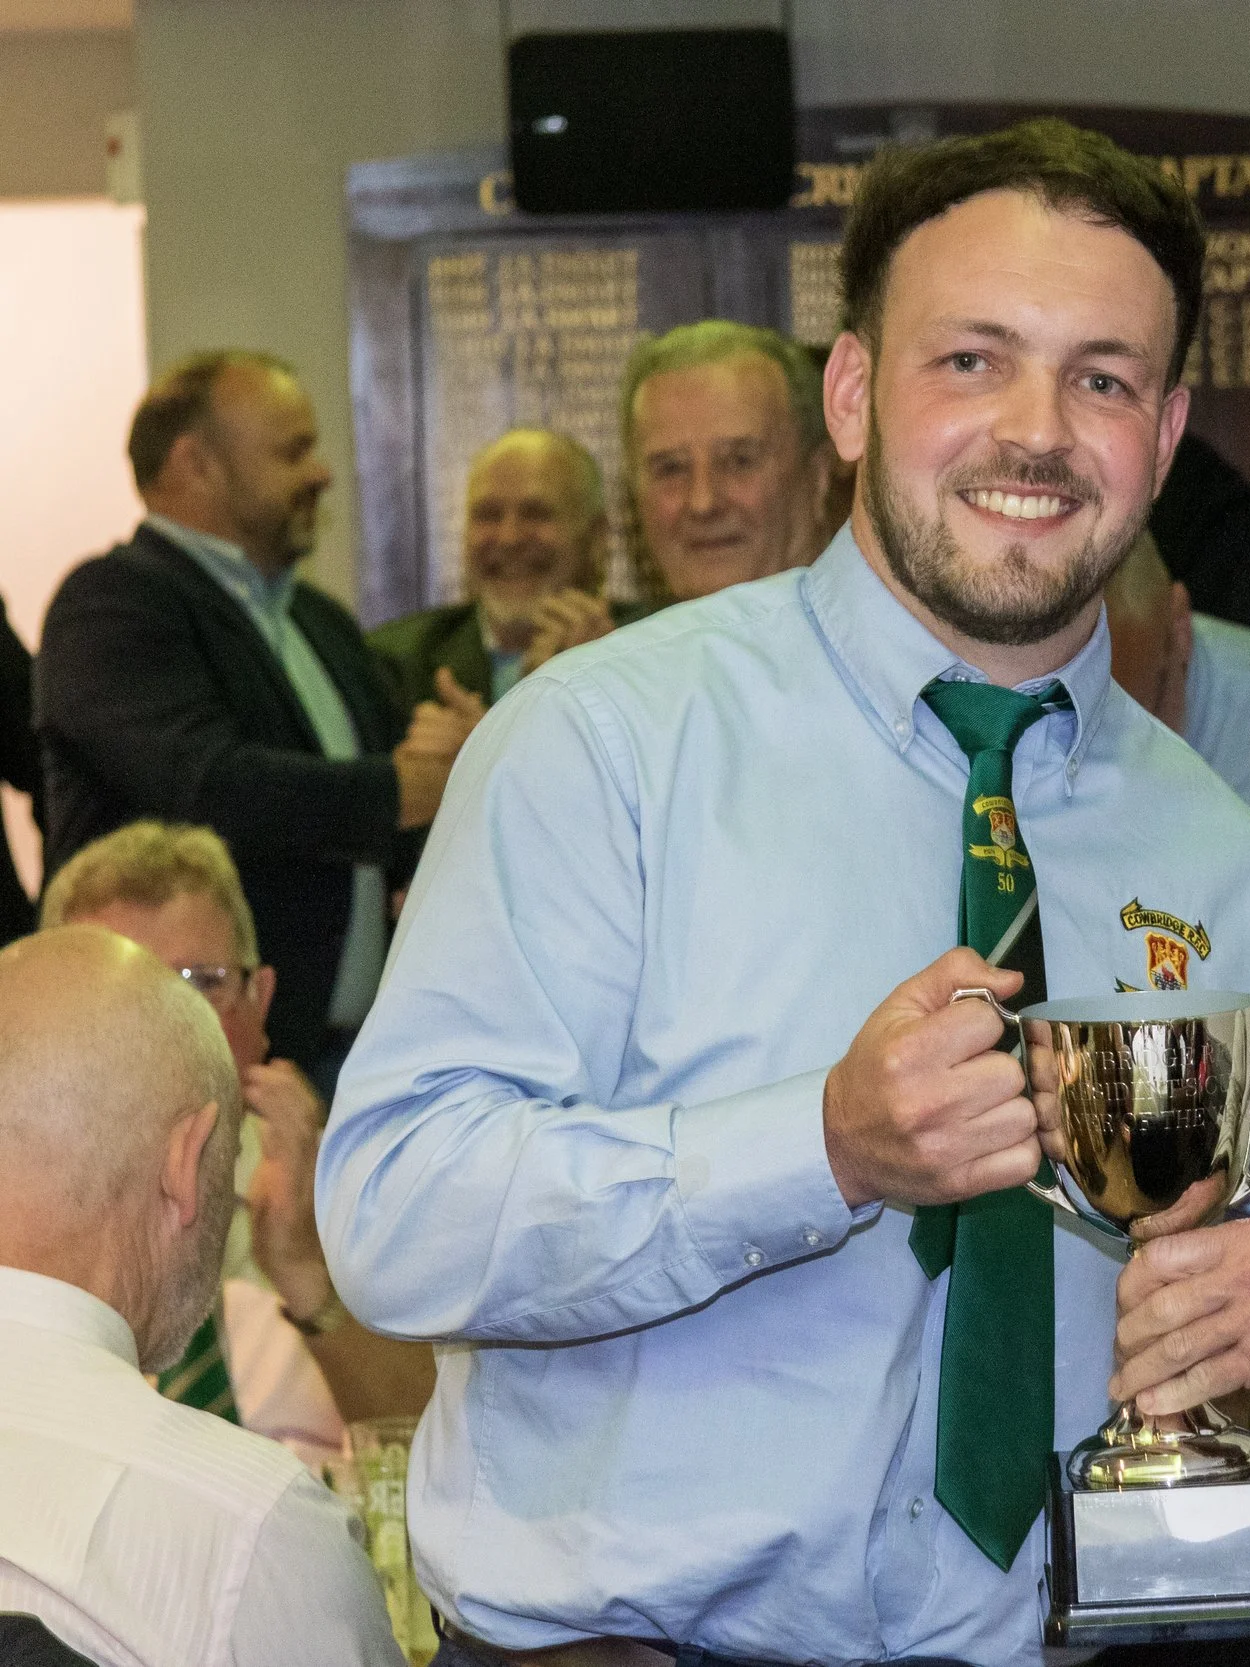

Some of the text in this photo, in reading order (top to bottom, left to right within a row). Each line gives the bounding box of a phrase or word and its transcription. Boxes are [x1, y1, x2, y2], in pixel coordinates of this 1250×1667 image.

[997, 873, 1014, 892] 50
[1127, 911, 1186, 936] COWBRIDGE
[1083, 1046, 1193, 1070] BRIDGE
[1160, 1108, 1205, 1130] THE
